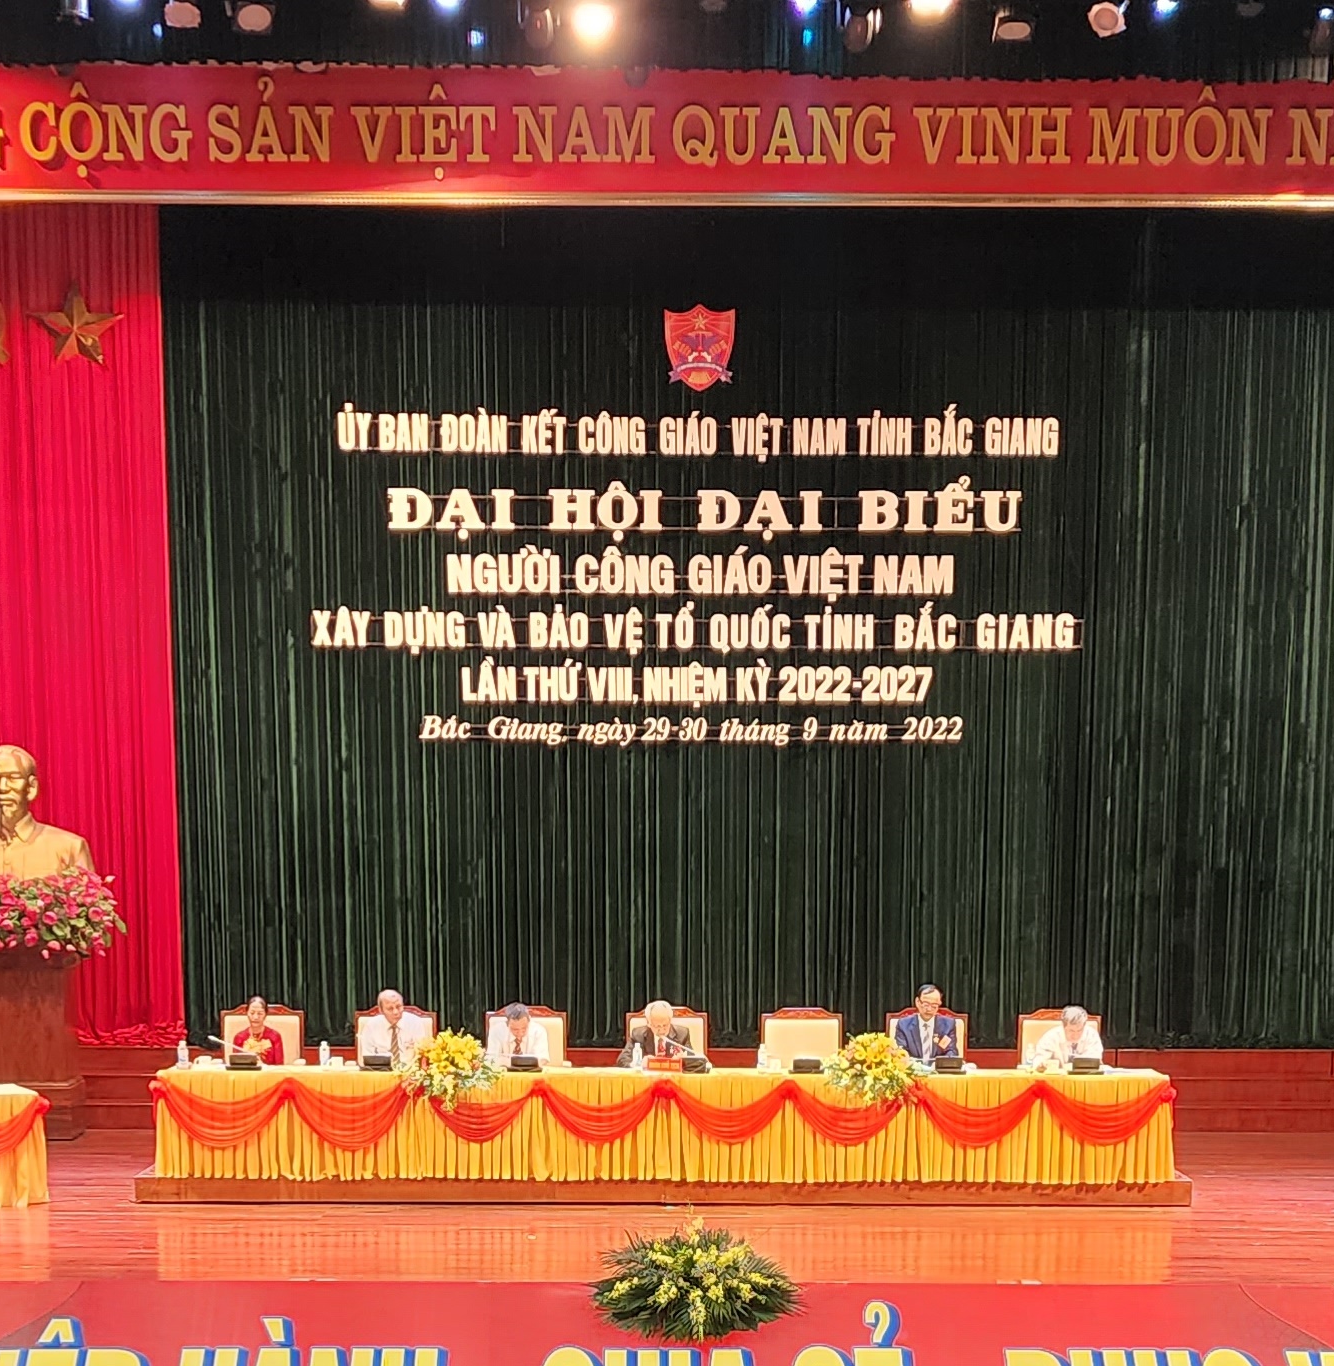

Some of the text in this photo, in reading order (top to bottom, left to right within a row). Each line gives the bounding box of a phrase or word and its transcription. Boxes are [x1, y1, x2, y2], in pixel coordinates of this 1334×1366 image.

[20, 82, 192, 178] CỘNG
[208, 76, 335, 163] SẢN
[350, 83, 497, 182] VIỆT
[513, 105, 656, 164] NAM
[672, 105, 896, 168] QUANG
[914, 106, 1070, 166] VINH
[1087, 86, 1270, 166] MUÔN
[379, 413, 428, 453] BAN
[440, 407, 507, 454] ĐOÀN
[522, 409, 566, 454] KẾT
[578, 411, 646, 455] CÔNG
[659, 411, 717, 456] GIÁO
[731, 413, 783, 462] VIỆT
[793, 417, 846, 456] NAM
[857, 410, 912, 456] TỈNH
[924, 404, 973, 456] BẮC
[985, 417, 1059, 457] GIANG
[387, 475, 1022, 542] ĐẠI HỘI ĐẠI BIỂU
[446, 544, 954, 602] NGƯỜI CÔNG GIÁO VIỆT NAM
[312, 601, 1075, 655] XÂY DỰNG VÀ BẢO VỆ TỔ QUỐC TỈNH BẮC GIANG
[461, 656, 517, 702] LẦN
[523, 658, 582, 702] THỨ
[643, 661, 727, 707] NHIỆM
[737, 658, 771, 701] KỲ
[779, 666, 933, 702] 2022-2027
[578, 717, 637, 746] ngày
[641, 716, 707, 742] 29-30
[721, 716, 790, 744] tháng
[803, 717, 817, 740] 9
[830, 719, 887, 740] năm
[904, 716, 963, 740] 2022
